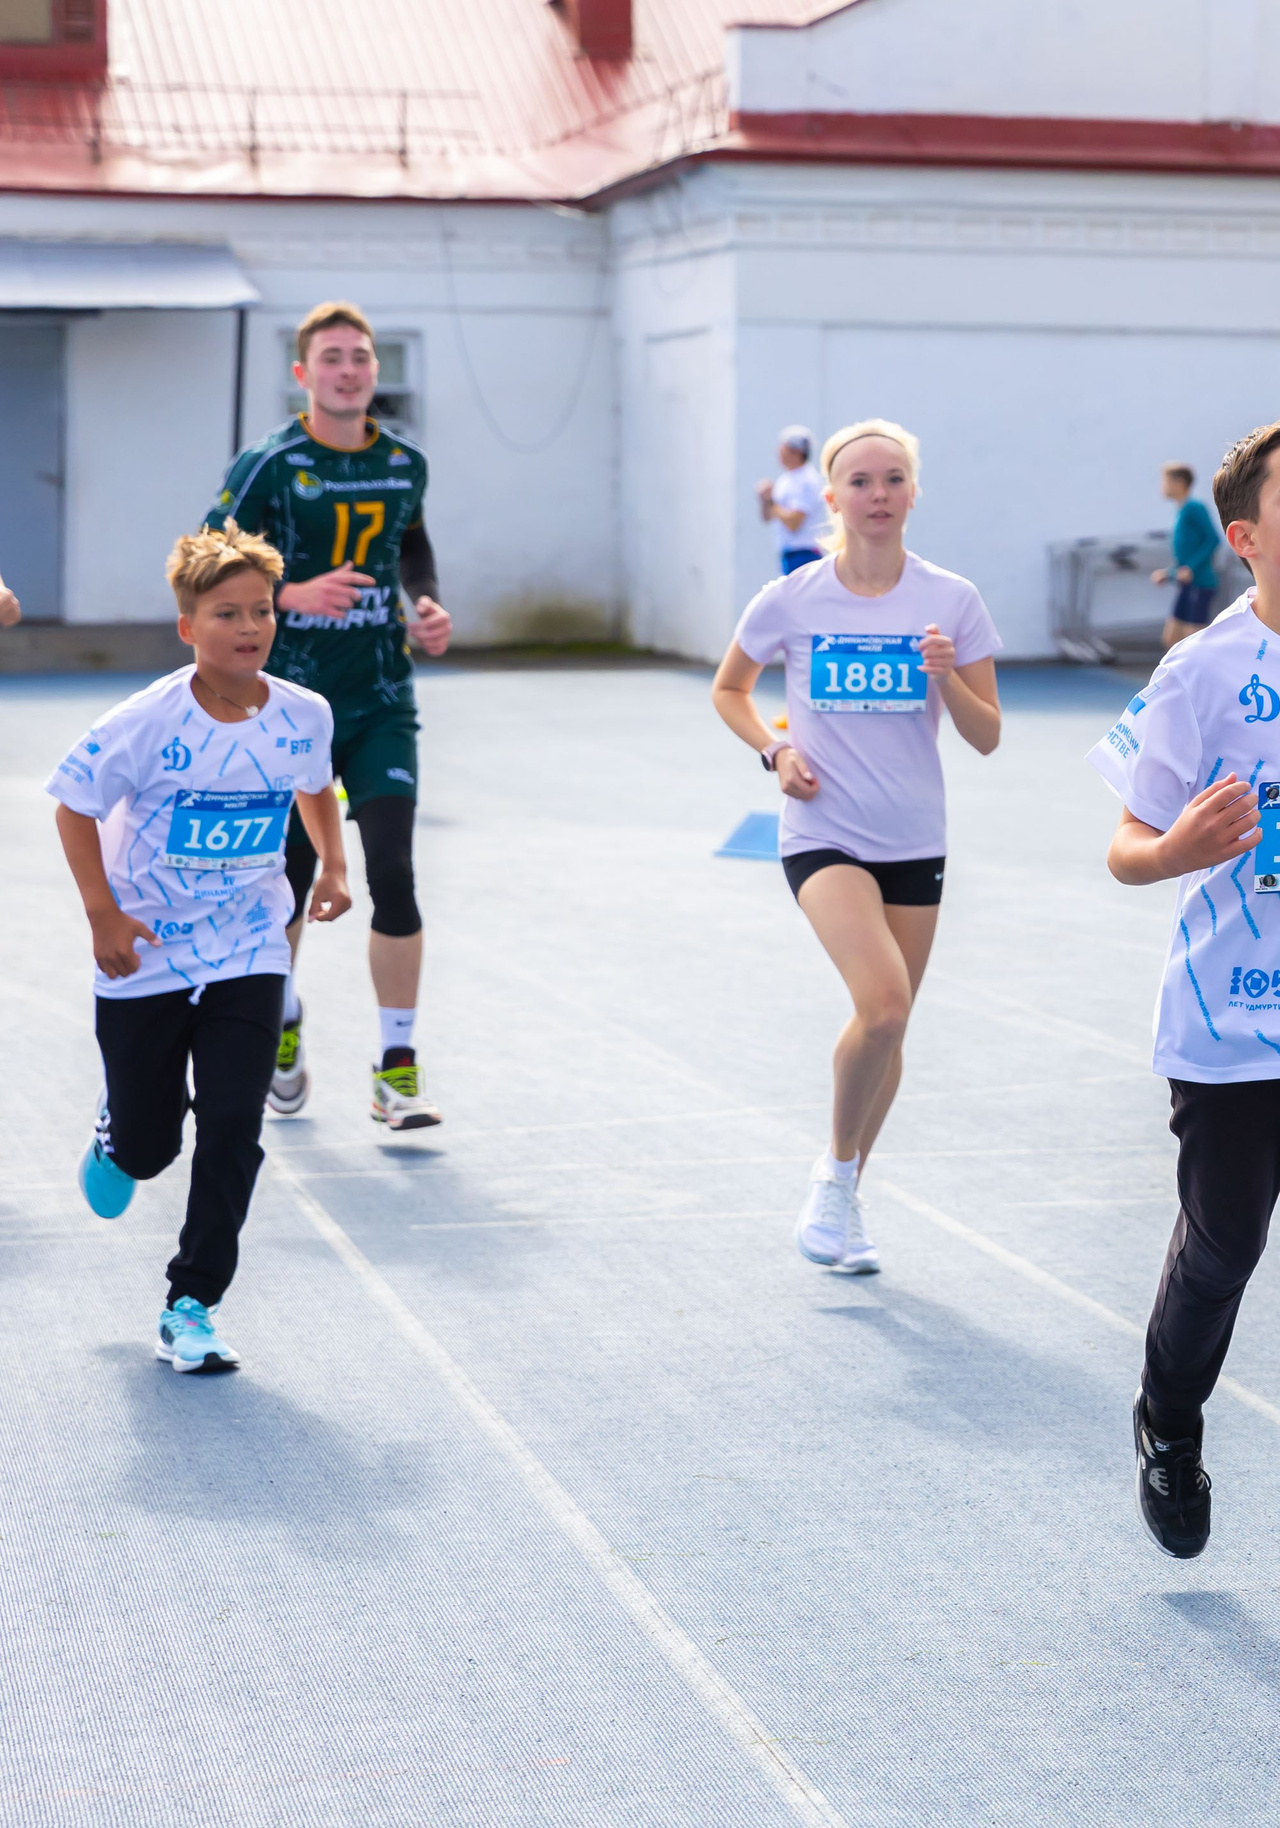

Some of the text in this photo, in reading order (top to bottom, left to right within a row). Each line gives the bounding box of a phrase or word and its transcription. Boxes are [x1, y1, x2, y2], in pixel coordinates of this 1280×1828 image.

[331, 501, 386, 567] 17
[825, 662, 913, 693] 1881
[291, 738, 313, 755] ВТБ
[184, 816, 273, 851] 1677
